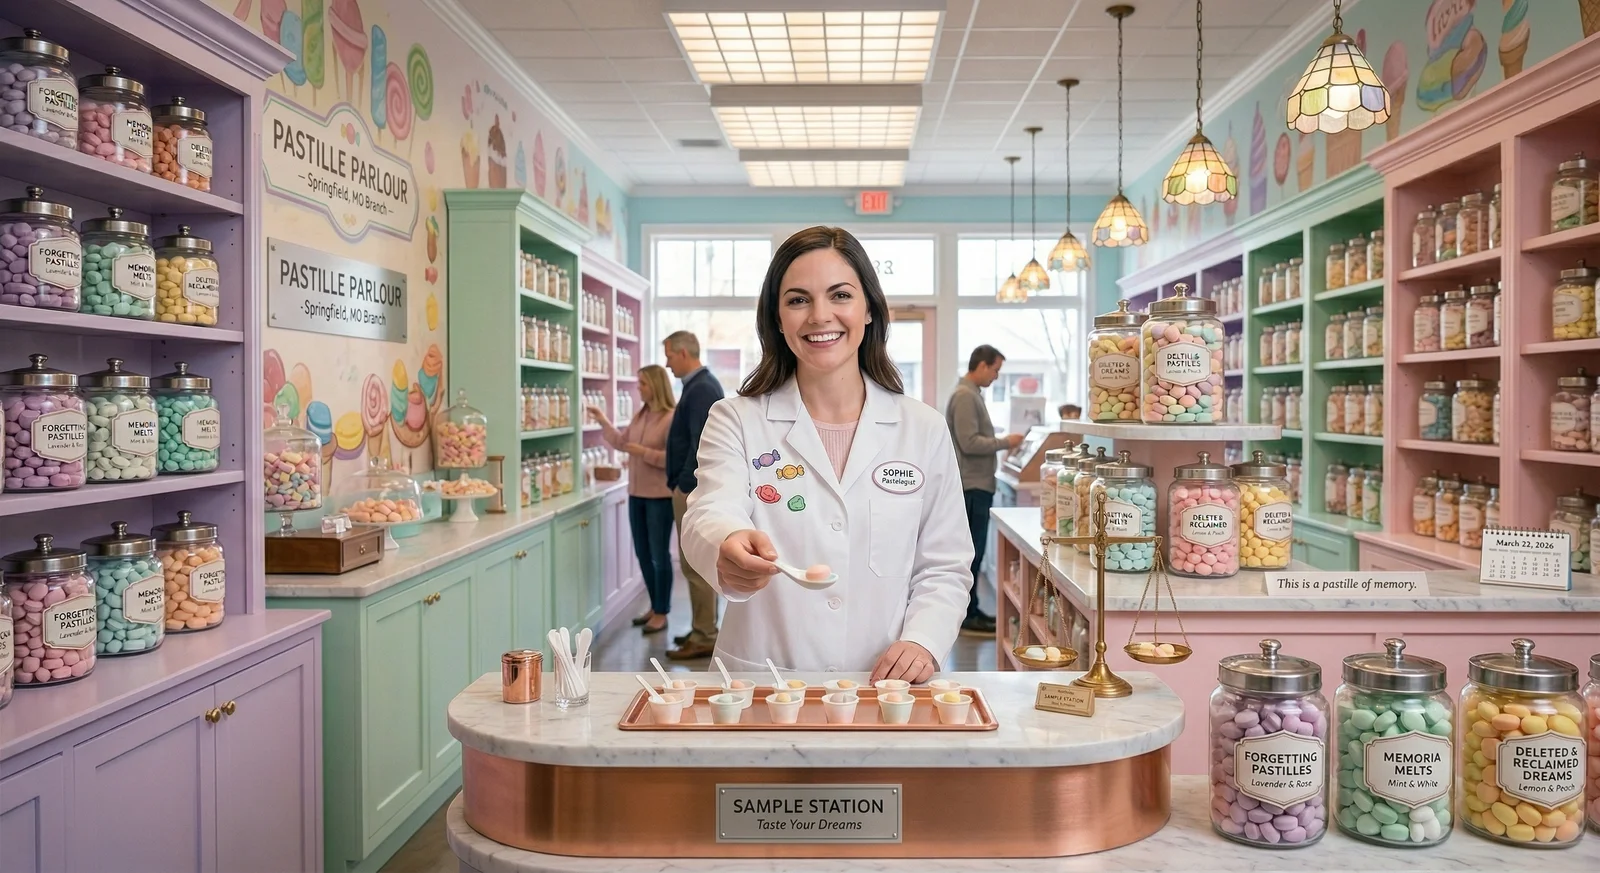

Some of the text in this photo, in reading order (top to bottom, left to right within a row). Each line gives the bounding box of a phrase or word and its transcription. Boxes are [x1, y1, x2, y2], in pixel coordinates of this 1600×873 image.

[274, 118, 408, 204] PASTILLE PARLOUR
[308, 172, 351, 204] Springfield,
[352, 190, 364, 206] MO
[366, 196, 388, 215] Branch
[280, 259, 402, 308] PASTILLE PARLOUR
[350, 308, 361, 322] MO
[364, 310, 386, 326] Branch
[882, 468, 914, 478] SOPHIE
[1522, 540, 1534, 549] 22,
[1277, 578, 1299, 589] This
[1302, 579, 1310, 589] is
[1322, 578, 1358, 591] pastille
[1361, 578, 1373, 591] of
[1374, 581, 1417, 592] memory.
[1244, 751, 1318, 764] FORGETTING
[1384, 752, 1442, 763] MEMORIA
[1516, 746, 1578, 758] DELETED &
[1252, 764, 1312, 776] PASTILLES
[1513, 758, 1578, 770] RECLAIMED
[1394, 765, 1432, 776] MELTS
[1523, 771, 1572, 781] DREAMS
[1251, 779, 1312, 788] Lavender & Rose
[1388, 779, 1438, 788] Mint & White
[1518, 784, 1576, 793] Lemon & Peach
[733, 799, 884, 814] SAMPLE STATION
[757, 819, 862, 830] Taste Your Dreams
